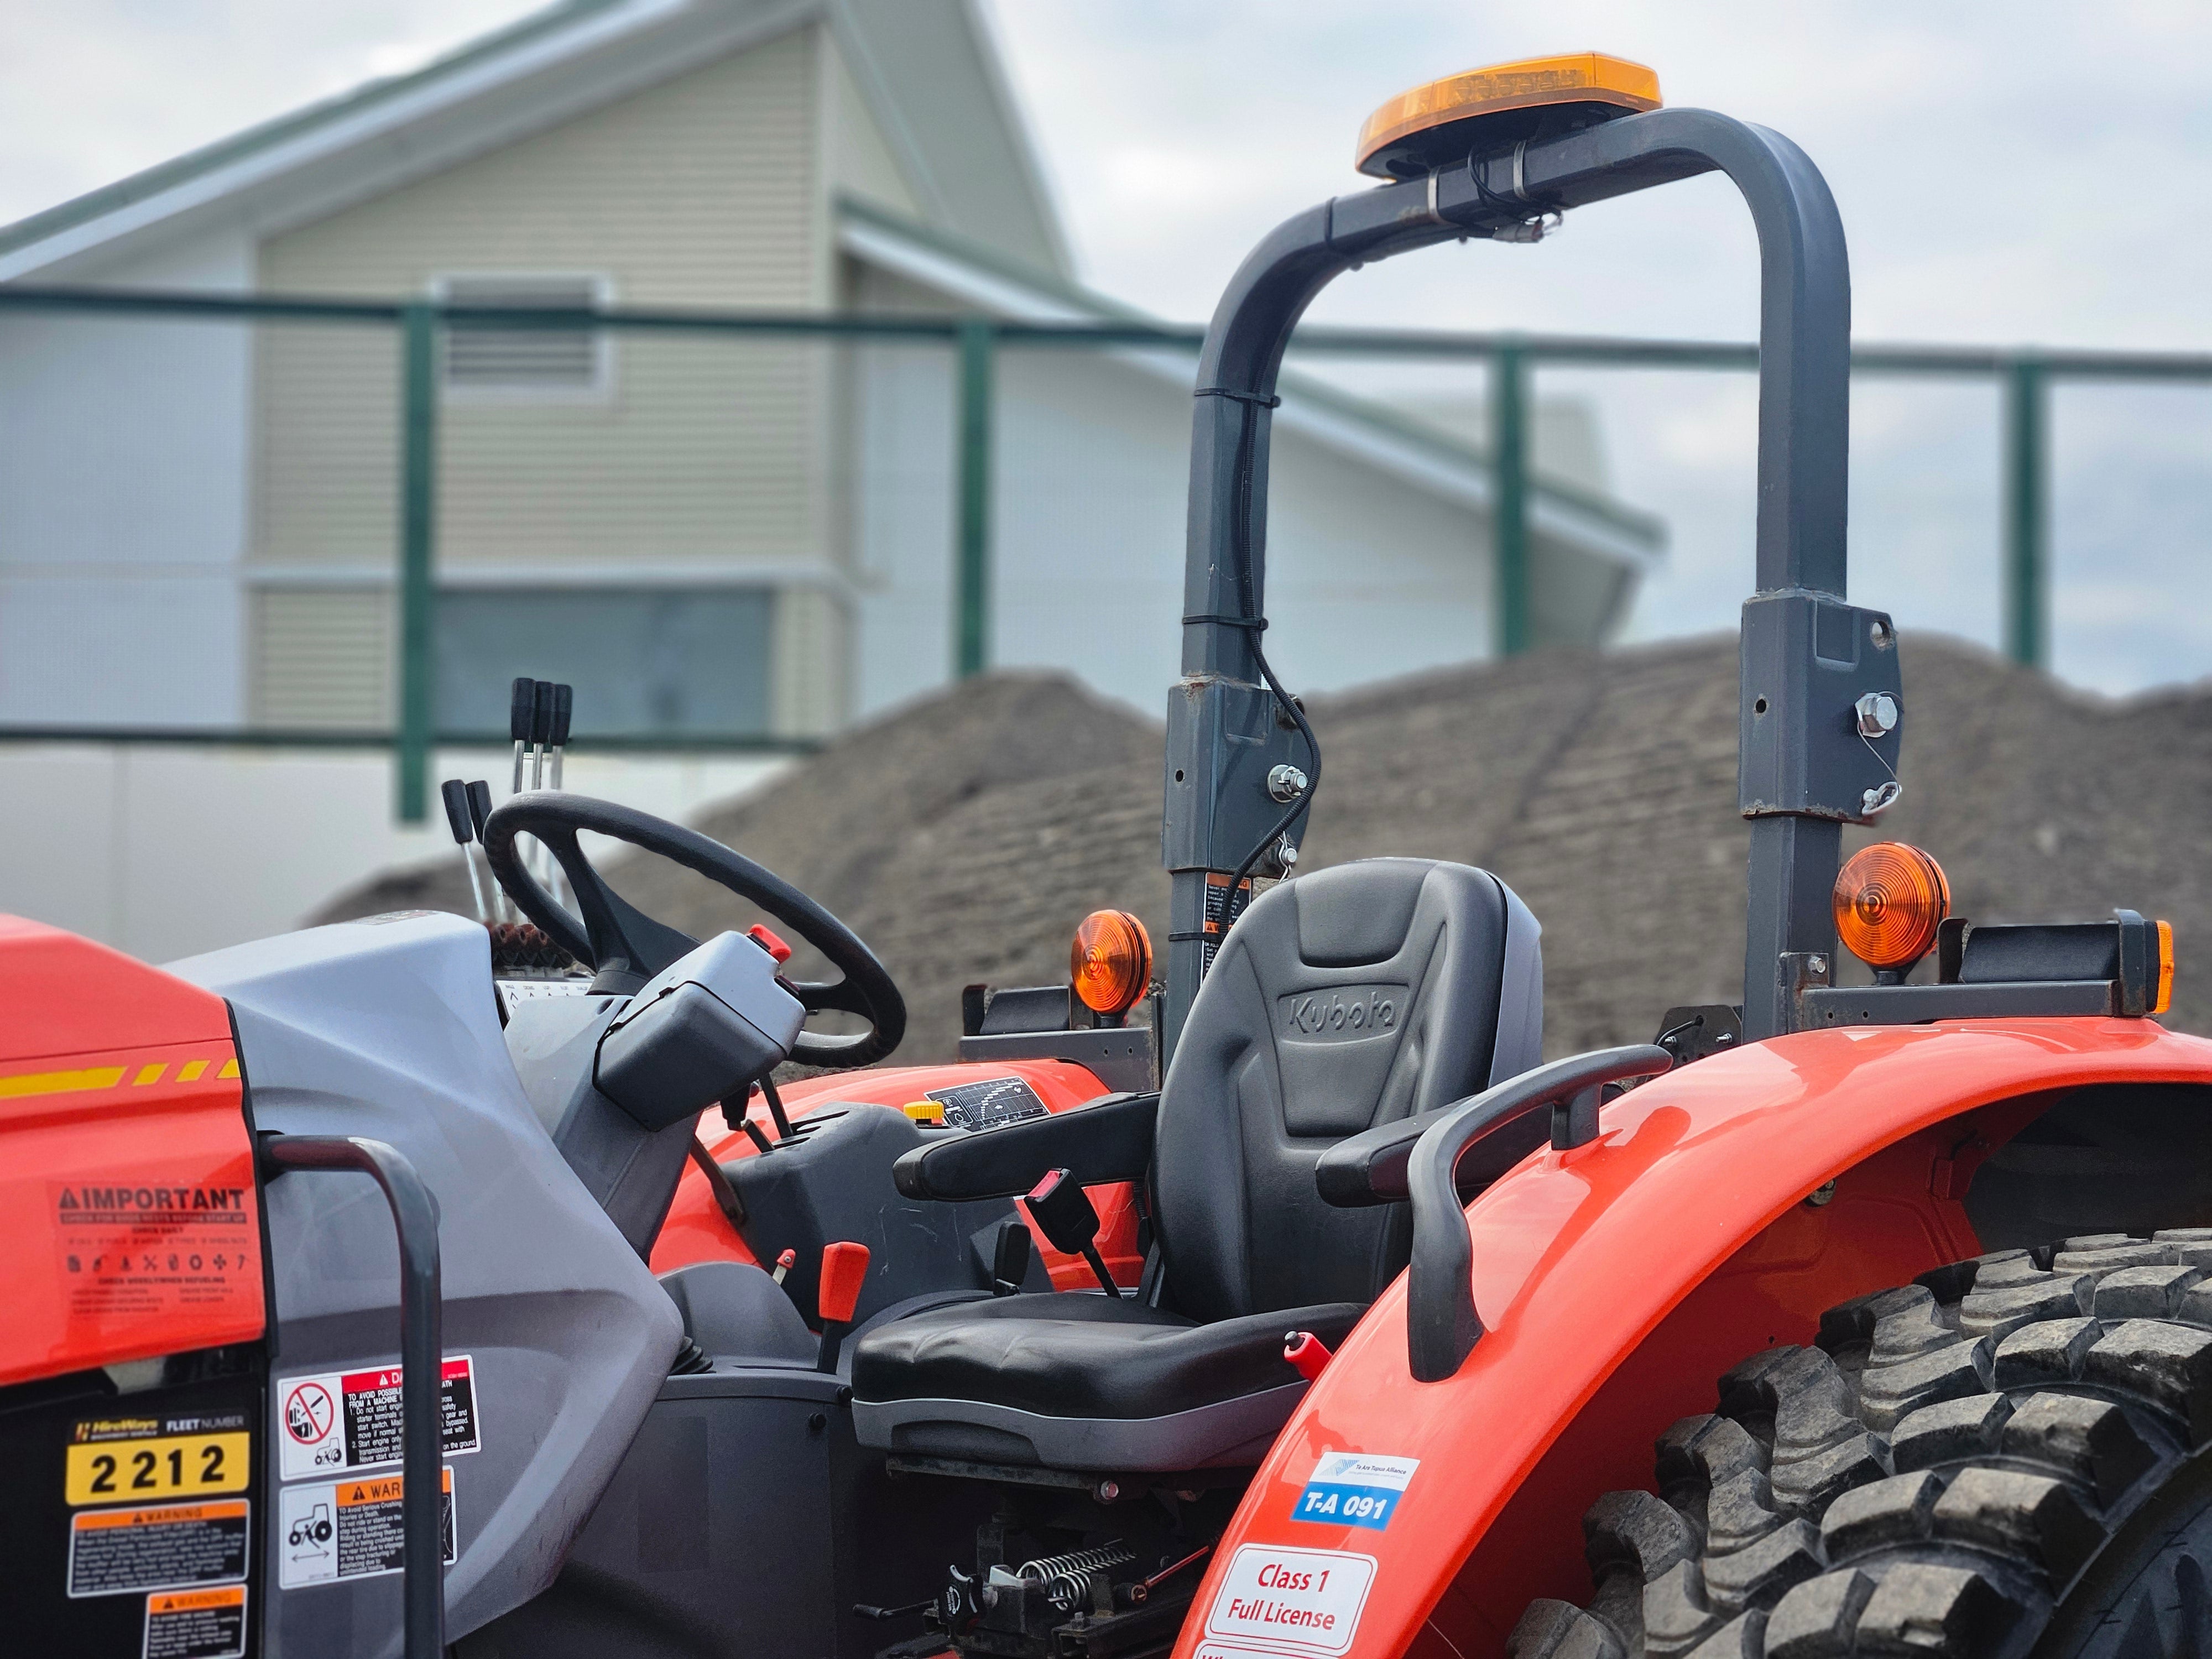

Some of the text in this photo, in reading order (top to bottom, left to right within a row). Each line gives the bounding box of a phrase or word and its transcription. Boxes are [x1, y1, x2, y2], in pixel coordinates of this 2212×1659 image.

[1289, 991, 1396, 1034] Kubota
[82, 1188, 244, 1210] IMPORTANT
[348, 1380, 452, 1401] TO AVOID POSSIBLE ATH
[349, 1400, 364, 1409] FROM
[373, 1395, 397, 1405] MACHINE
[446, 1411, 456, 1420] gear
[458, 1408, 467, 1417] and
[372, 1437, 389, 1446] engine
[379, 1427, 396, 1436] normal
[90, 1444, 225, 1494] 2212
[1304, 1492, 1387, 1519] T-A 091
[1258, 1564, 1330, 1593] Class 1
[1227, 1599, 1335, 1630] Full License
